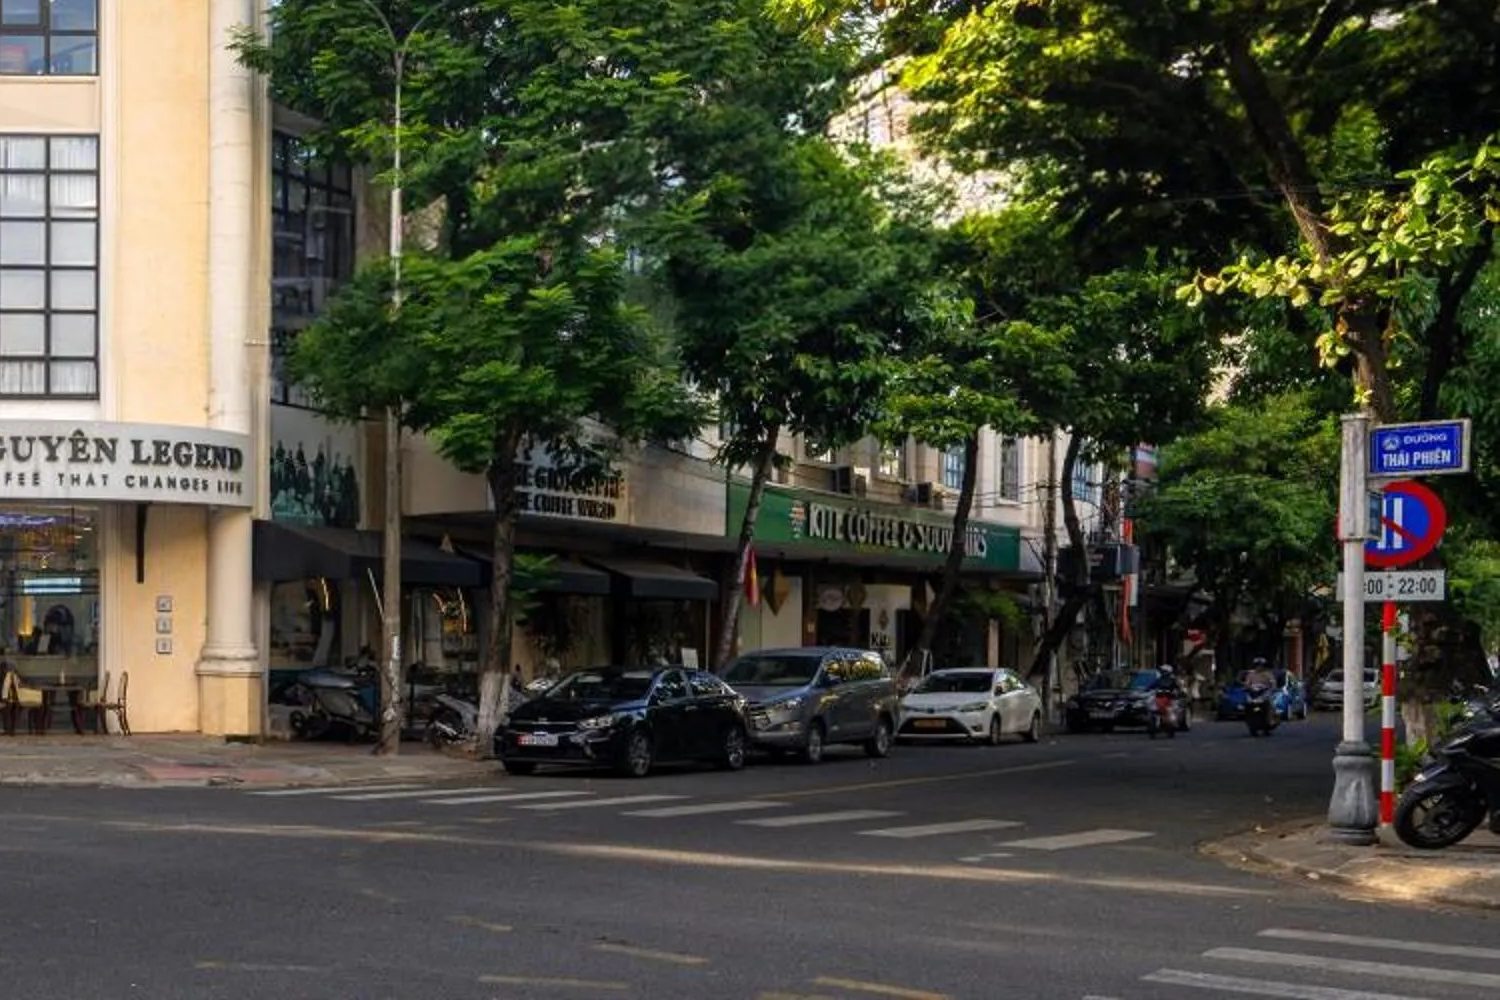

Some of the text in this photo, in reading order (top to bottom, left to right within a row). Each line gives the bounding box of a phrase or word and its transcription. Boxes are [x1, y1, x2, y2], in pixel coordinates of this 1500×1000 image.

[130, 439, 244, 472] LEGEND
[57, 472, 109, 487] THAT
[125, 474, 209, 491] CHANGES
[217, 478, 244, 494] LIFE
[809, 502, 844, 540] KITE
[846, 511, 899, 548] COFFEE
[1398, 577, 1437, 595] 22:00
